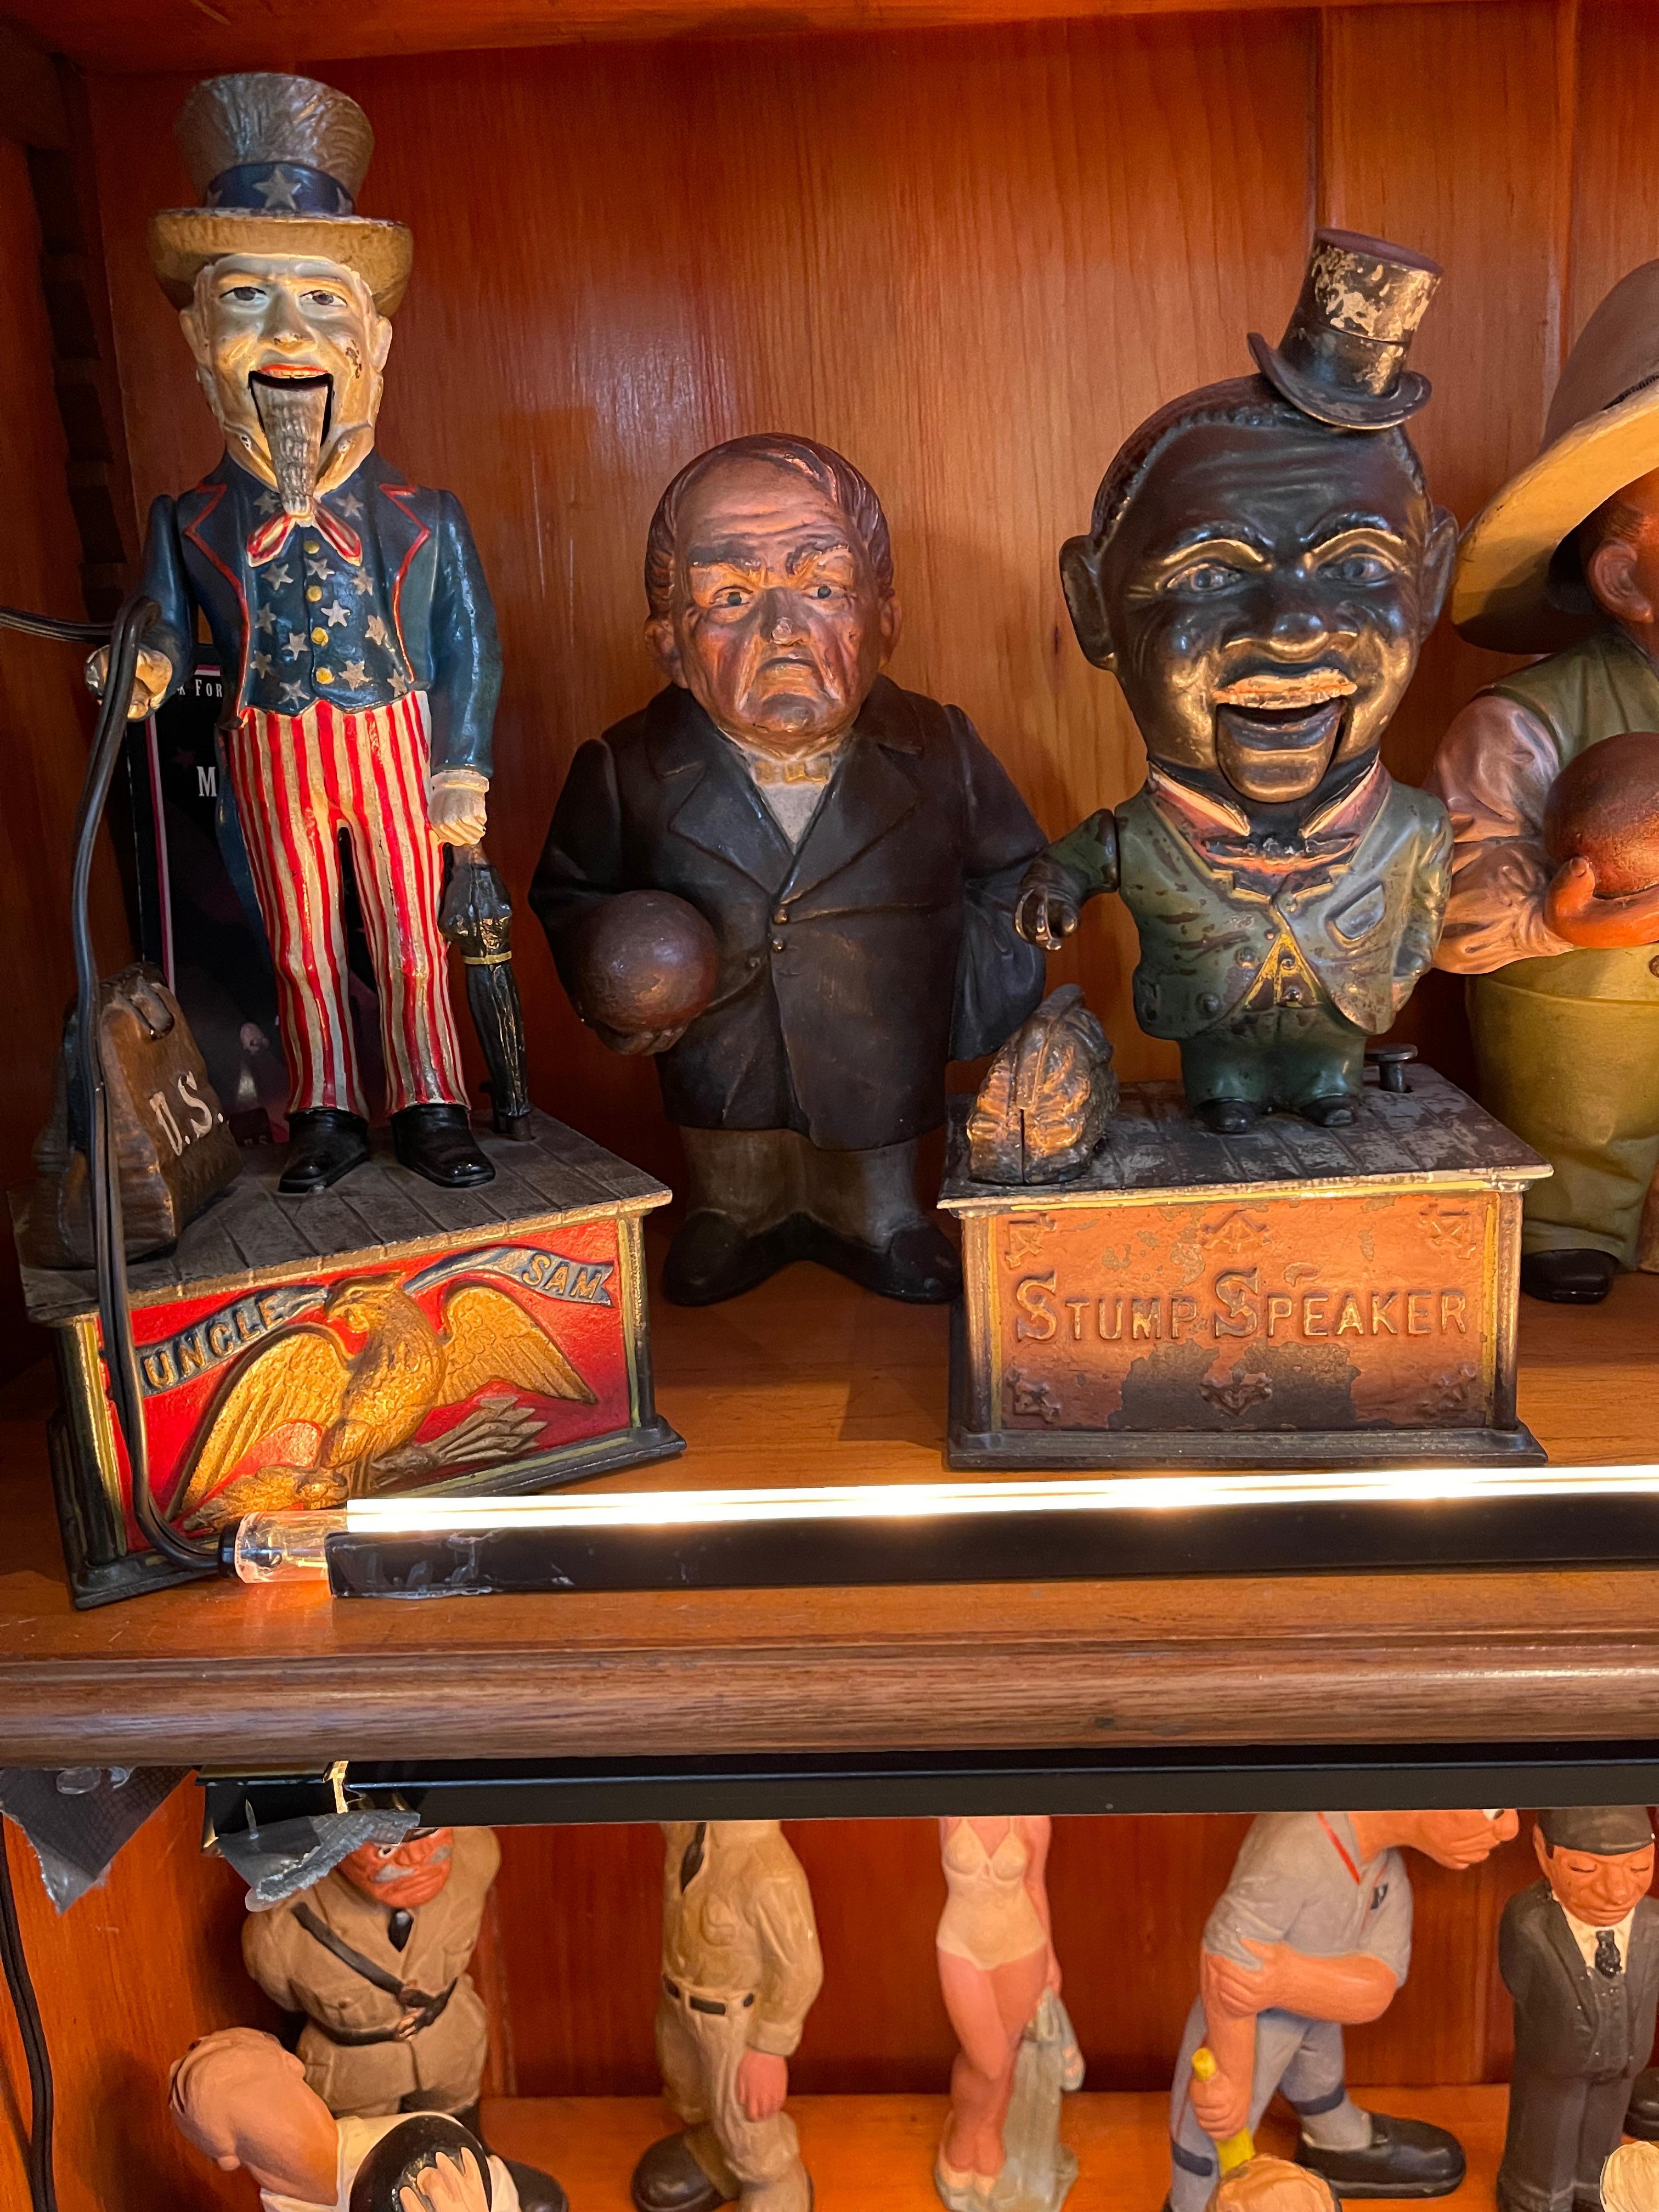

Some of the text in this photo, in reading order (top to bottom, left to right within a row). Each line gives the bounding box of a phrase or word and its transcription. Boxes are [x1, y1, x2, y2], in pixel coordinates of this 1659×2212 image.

[149, 1070, 224, 1156] U.S.
[142, 1252, 602, 1389] UNCLE SAM
[1016, 1267, 1466, 1342] STUMP SPEAKER
